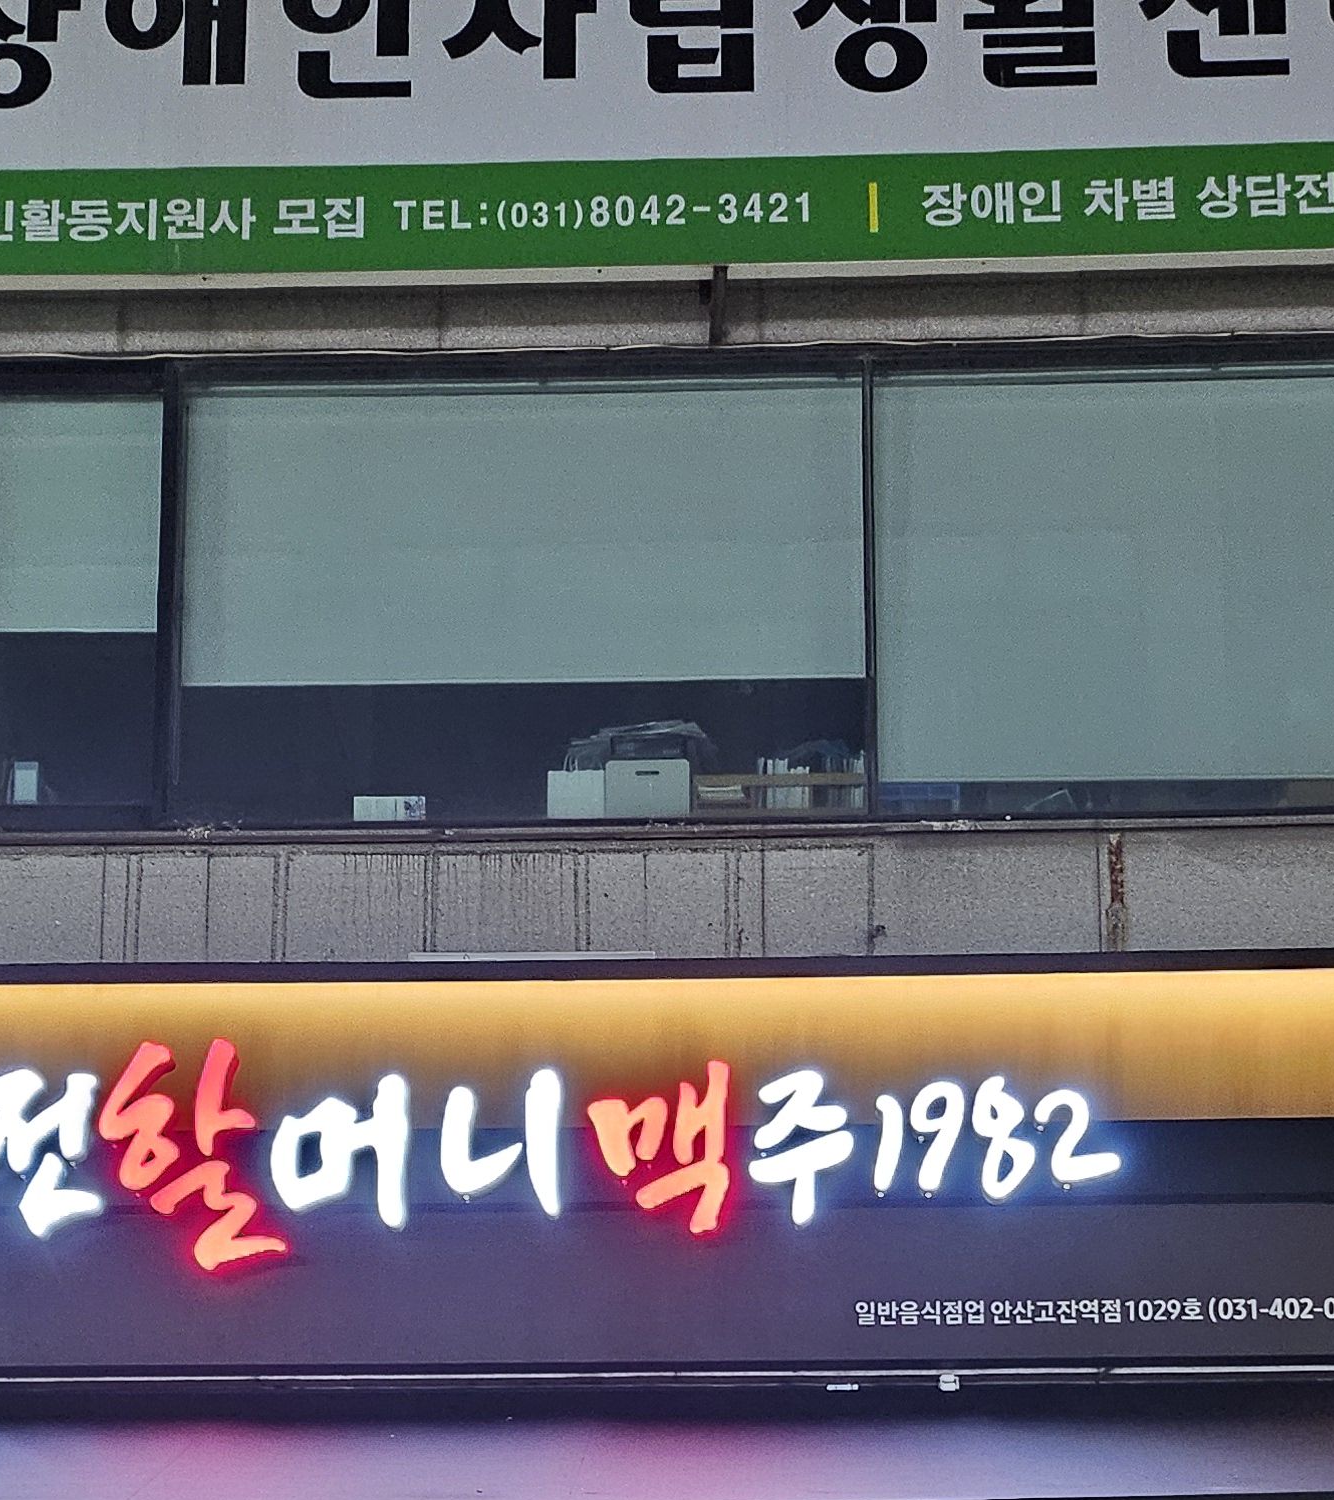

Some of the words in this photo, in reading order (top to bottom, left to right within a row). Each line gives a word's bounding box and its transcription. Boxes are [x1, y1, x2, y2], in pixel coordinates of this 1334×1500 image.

[273, 196, 365, 239] 모집
[921, 183, 1061, 228] 장애인
[1083, 175, 1178, 222] 차별
[854, 1300, 986, 1327] 일반음식점업
